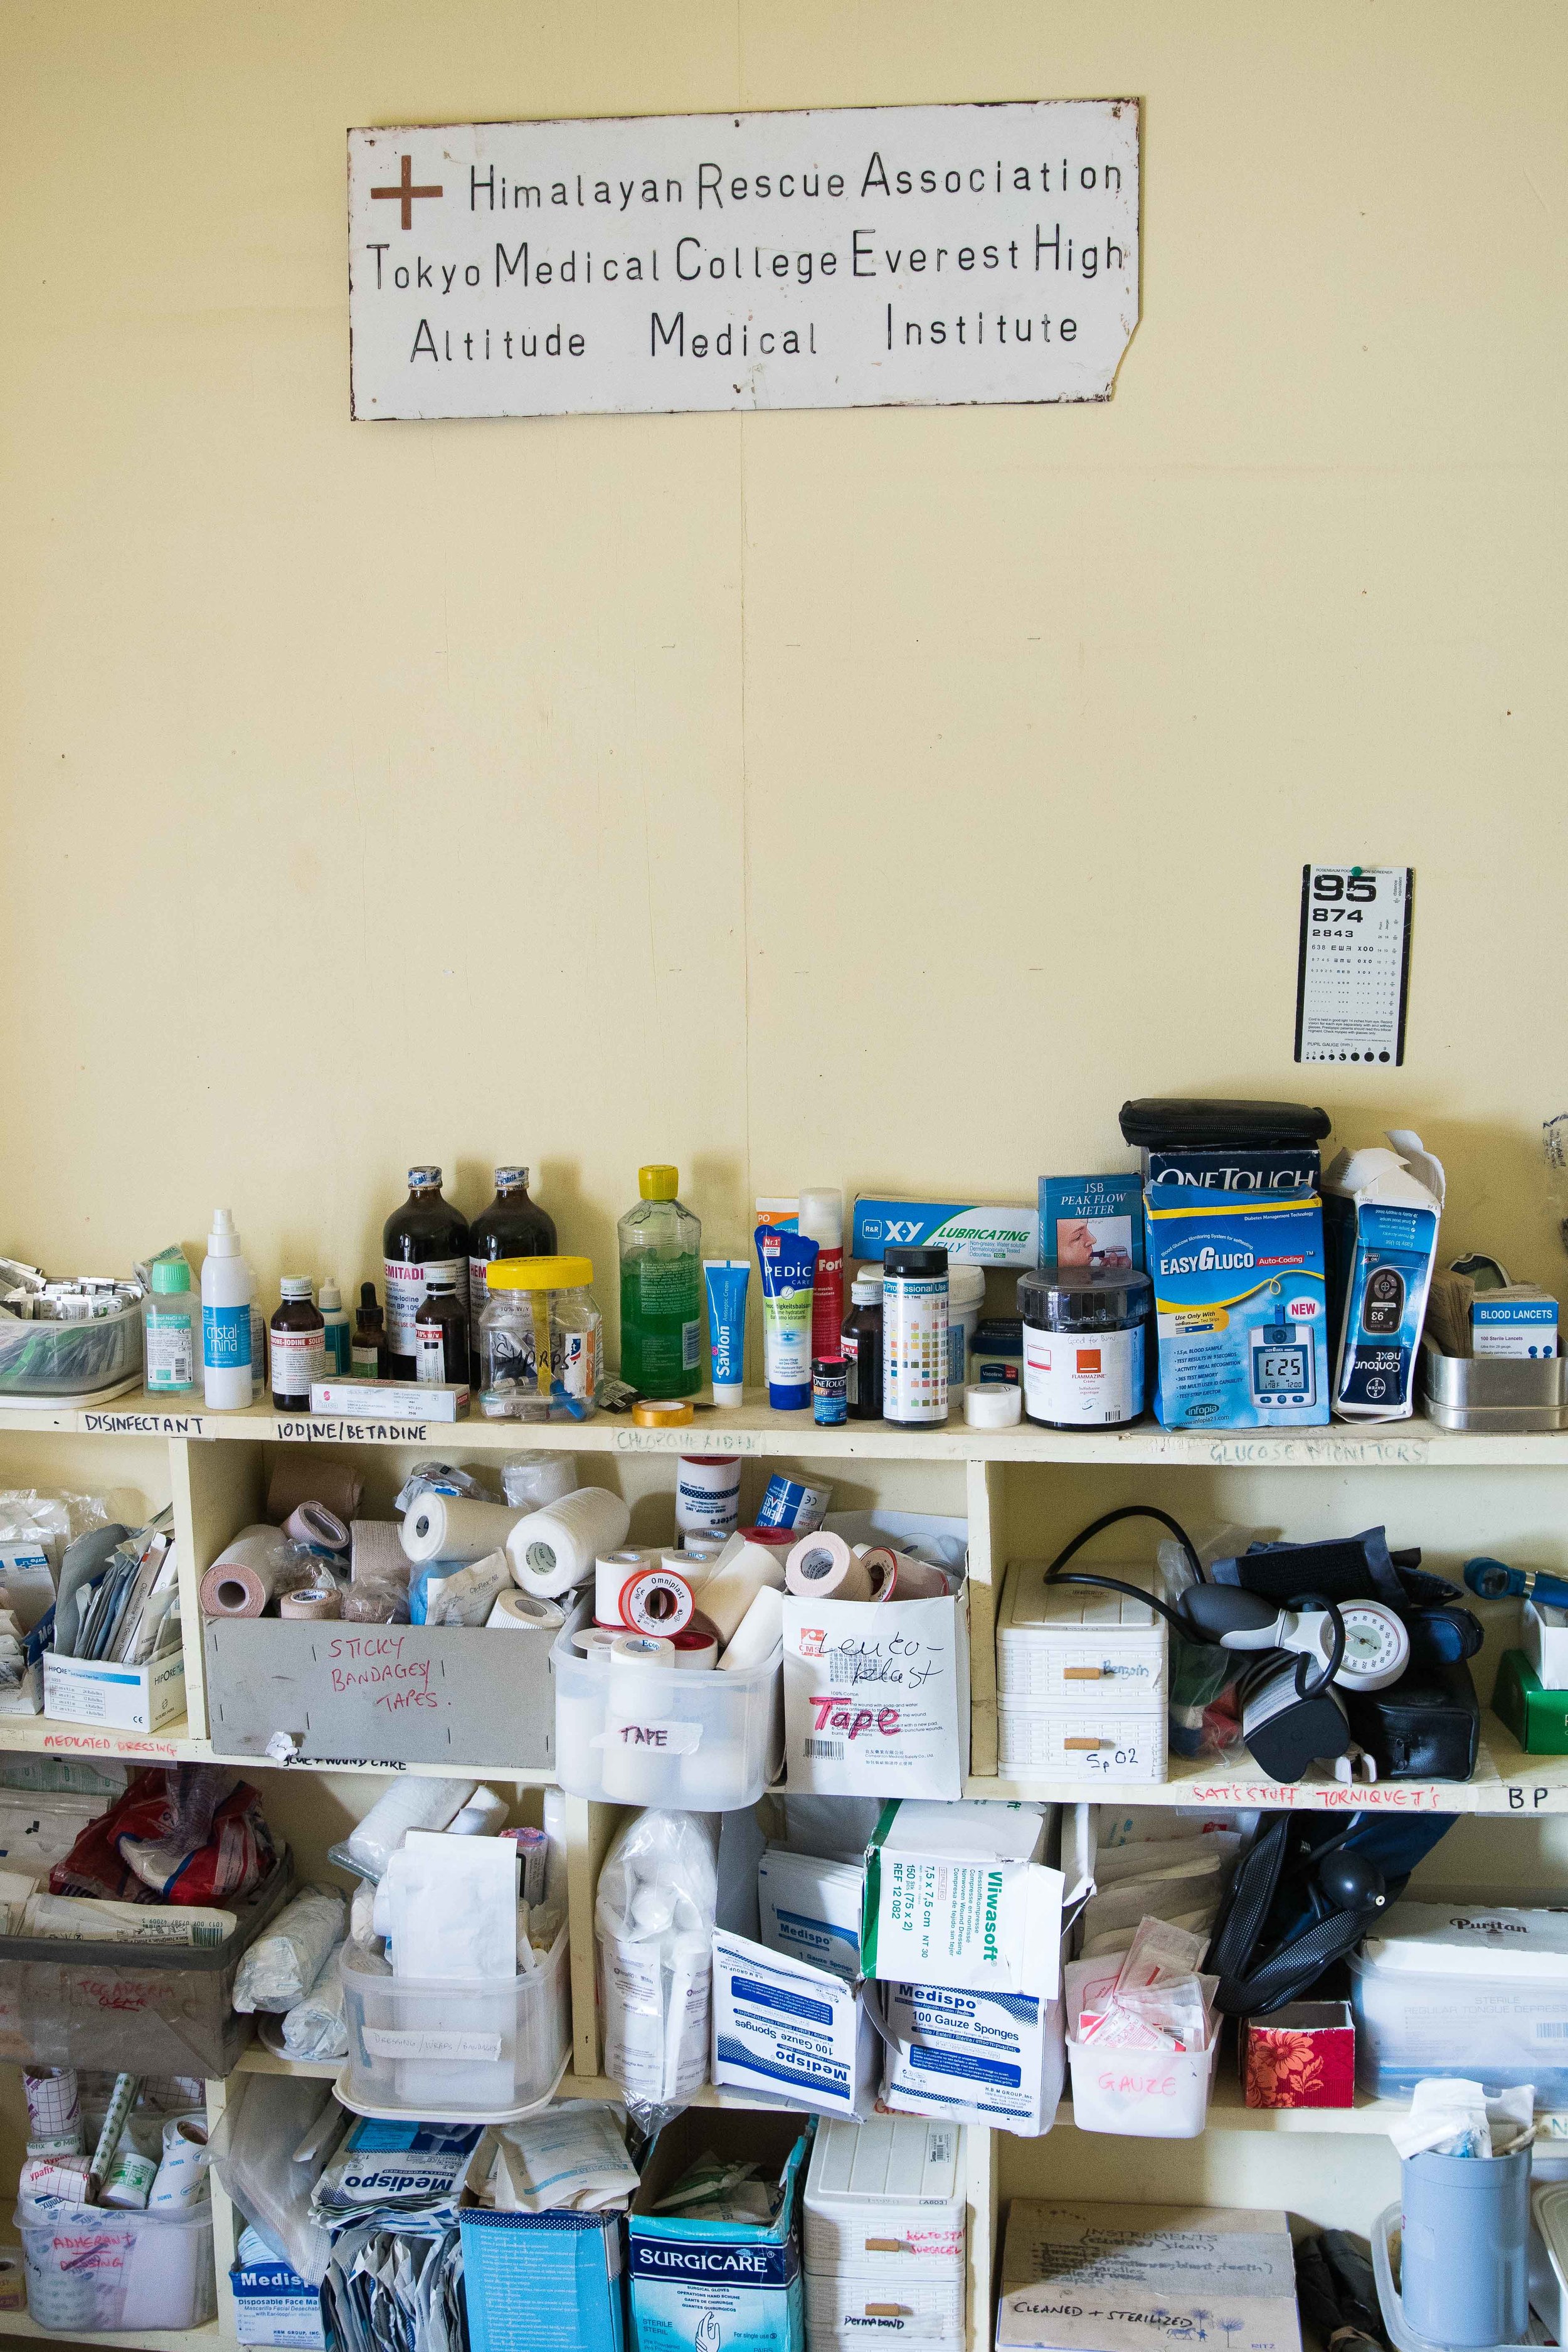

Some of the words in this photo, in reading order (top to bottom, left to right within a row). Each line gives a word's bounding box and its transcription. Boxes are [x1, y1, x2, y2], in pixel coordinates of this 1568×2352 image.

[470, 164, 683, 212] Himalayan
[698, 163, 845, 210] Rescue
[861, 151, 1121, 198] Association
[366, 243, 480, 294] Tokyo
[496, 241, 659, 287] Medical
[675, 236, 837, 284] College
[852, 229, 1019, 277] Everest
[1036, 223, 1123, 278] High
[410, 319, 585, 363] Altitude
[651, 311, 817, 358] Medical
[887, 303, 1078, 351] Institute
[1313, 874, 1377, 903] 95
[1312, 908, 1364, 923] 874
[1084, 1182, 1104, 1194] JSB
[1061, 1195, 1093, 1205] PEAK
[1094, 1192, 1126, 1204] FLOW
[1075, 1205, 1114, 1216] METER
[865, 1226, 879, 1234] R&R
[937, 1227, 1030, 1242] LUBRICATING
[1401, 1239, 1414, 1248] Easy
[1258, 1256, 1303, 1265] Auto-Coding
[1291, 1303, 1316, 1315] NEW
[1371, 1311, 1384, 1322] 93
[1481, 1310, 1510, 1319] BLOOD
[1513, 1310, 1552, 1319] LANCETS
[210, 1339, 238, 1352] mina
[716, 1325, 730, 1376] Savlon
[1376, 1352, 1401, 1360] next
[1355, 1361, 1401, 1372] Contour
[1187, 1405, 1218, 1416] infopia
[85, 1414, 203, 1434] DISINFECTANT
[1179, 1415, 1229, 1426] www.infopia21.com
[277, 1422, 427, 1441] IODINE/BETADINE
[1210, 1443, 1294, 1465] GLUCOSE
[651, 1577, 686, 1601] Omniplast
[329, 1636, 405, 1660] STICKY
[48, 1666, 68, 1675] HIPORE
[154, 1666, 176, 1685] HIPORE
[1103, 1660, 1149, 1678] Benzoin
[808, 1697, 901, 1740] Tape
[620, 1725, 668, 1746] TAPE
[893, 1863, 903, 1882] REF
[906, 1865, 916, 1879] 150
[924, 1866, 935, 1879] 7,5
[894, 1885, 903, 1897] 12
[951, 1868, 960, 1899] Compresa
[923, 1892, 934, 1907] 7,5
[974, 1870, 983, 1934] Vliesstoffkompresse
[892, 1900, 901, 1919] 082
[923, 1910, 931, 1927] cm
[983, 1871, 1003, 1961] Vliwasoft
[780, 1923, 830, 1945] Medispo
[1449, 1918, 1530, 1934] Puritan
[956, 1926, 965, 1956] Dressing
[807, 1954, 827, 1964] Gauze
[830, 1961, 853, 1972] Sponge
[899, 1984, 976, 2010] Medispo
[1475, 1996, 1521, 2005] STERILE
[1463, 2006, 1510, 2014] TONGUE
[735, 2019, 776, 2038] Sponges
[913, 2011, 931, 2023] 100
[935, 2015, 970, 2029] Gauze
[974, 2022, 1019, 2041] Sponges
[781, 2034, 813, 2051] Gauze
[815, 2043, 834, 2055] 100
[775, 2050, 847, 2082] Medispo
[1098, 2073, 1177, 2097] GAUZE
[344, 2173, 454, 2192] Medispo
[640, 2248, 768, 2273] SURGICARE
[642, 2319, 673, 2328] STERILE
[1014, 2301, 1083, 2317] CLEANED
[1106, 2310, 1194, 2328] STERILIZED
[643, 2326, 669, 2336] STERIL
